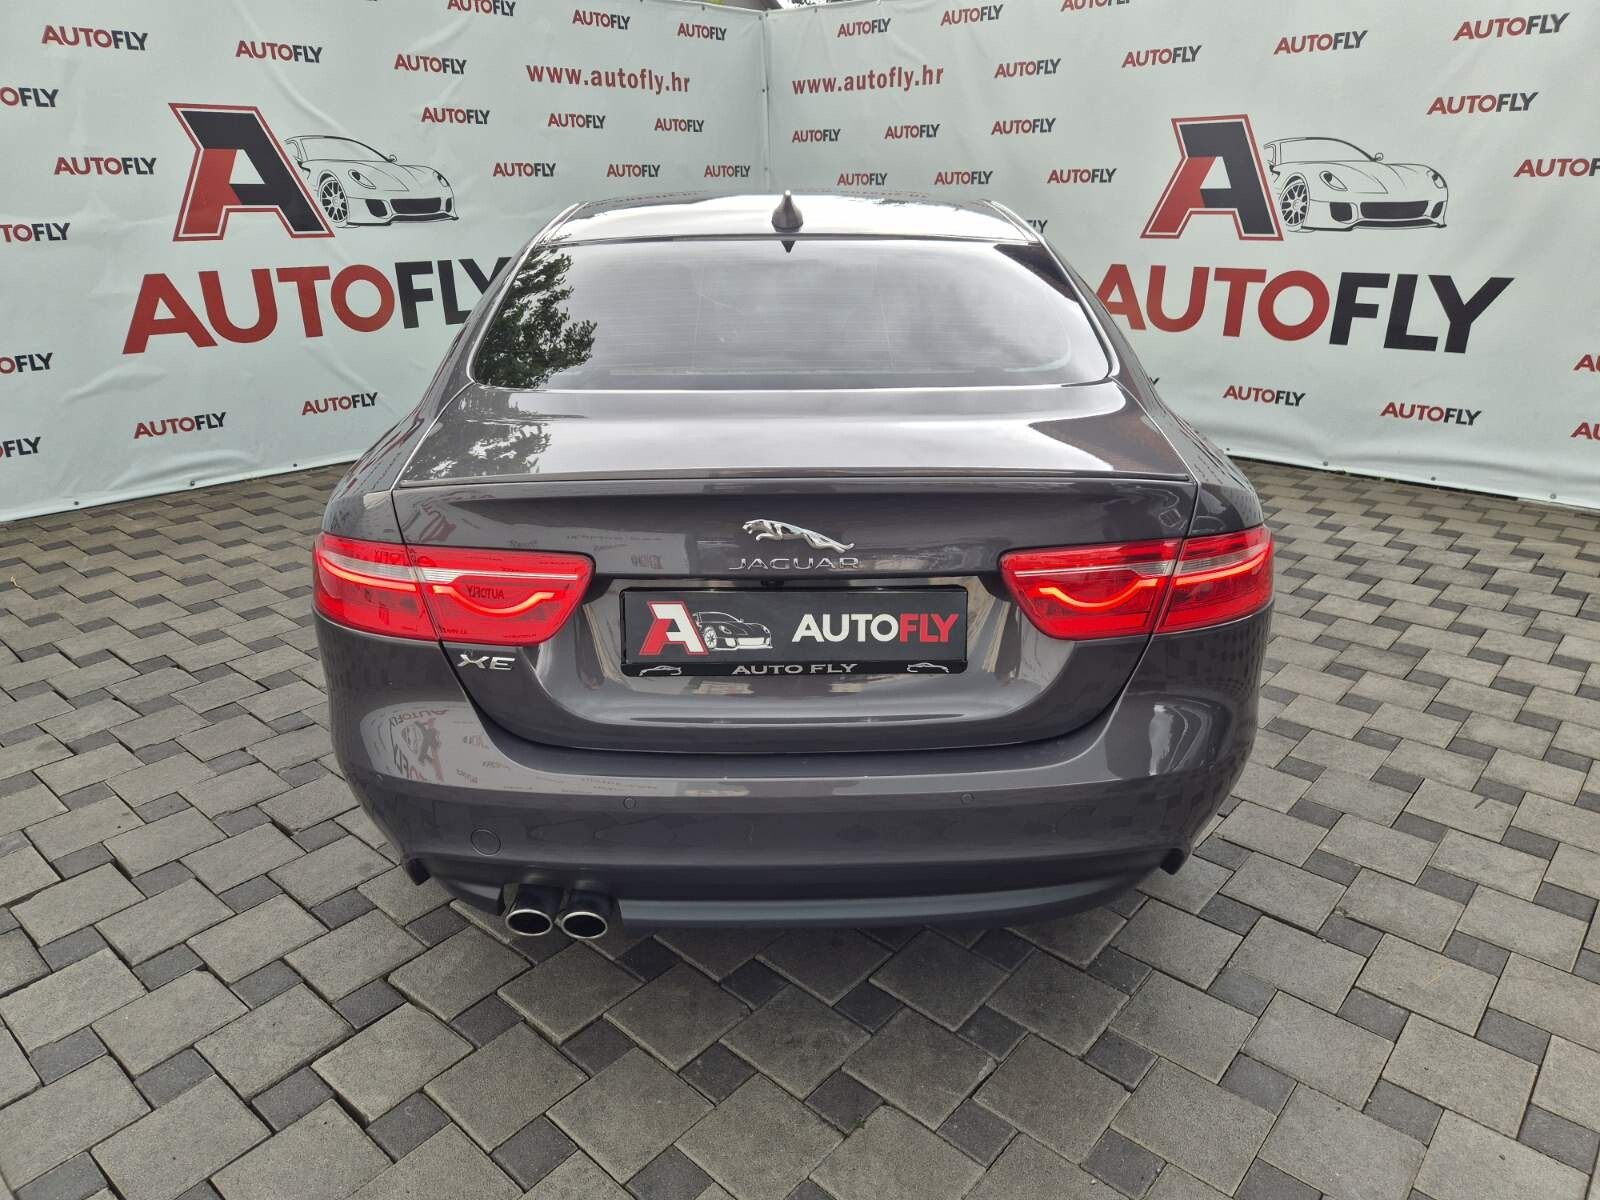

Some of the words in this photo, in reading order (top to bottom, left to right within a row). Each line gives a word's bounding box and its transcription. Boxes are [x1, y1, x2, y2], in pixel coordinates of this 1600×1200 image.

[573, 10, 630, 30] AUTOFLY
[941, 4, 1003, 26] AUTOFLY
[678, 23, 726, 40] AUTOFLY
[837, 18, 891, 37] AUTOFLY
[1453, 13, 1569, 40] AUTOFLY
[42, 25, 148, 50] AUTOFLY
[1274, 30, 1368, 55] AUTOFLY
[236, 41, 322, 63] AUTOFLY
[1122, 45, 1202, 68] AUTOFLY
[394, 54, 466, 74] AUTOFLY
[995, 58, 1061, 78] AUTOFLY
[526, 65, 690, 95] www.autofly.hr
[792, 65, 943, 95] www.autofly.hr
[1427, 92, 1538, 115] AUTOFLY
[421, 107, 490, 124] AUTOFLY
[548, 113, 605, 129] AUTOFLY
[655, 118, 704, 132] AUTOFLY
[792, 129, 840, 143] AUTOFLY
[885, 124, 940, 139] AUTOFLY
[991, 118, 1056, 135] AUTOFLY
[54, 157, 156, 175] AUTOFLY
[493, 163, 556, 177] AUTOFLY
[607, 164, 660, 177] AUTOFLY
[704, 165, 750, 177] AUTOFLY
[1047, 168, 1116, 184] AUTOFLY
[837, 173, 887, 185] AUTOFLY
[934, 171, 993, 185] AUTOFLY
[1096, 264, 1514, 353] AUTOFLY
[302, 392, 377, 415] AUTOFLY
[1223, 385, 1305, 406] AUTOFLY
[1380, 402, 1481, 425] AUTOFLY
[134, 412, 226, 439] AUTOFLY
[0, 437, 40, 457] FLY
[728, 558, 859, 570] JAGUAR
[792, 614, 959, 643] AUTOFLY
[457, 654, 516, 671] XE
[732, 664, 803, 675] AUTO
[810, 663, 858, 674] FLY
